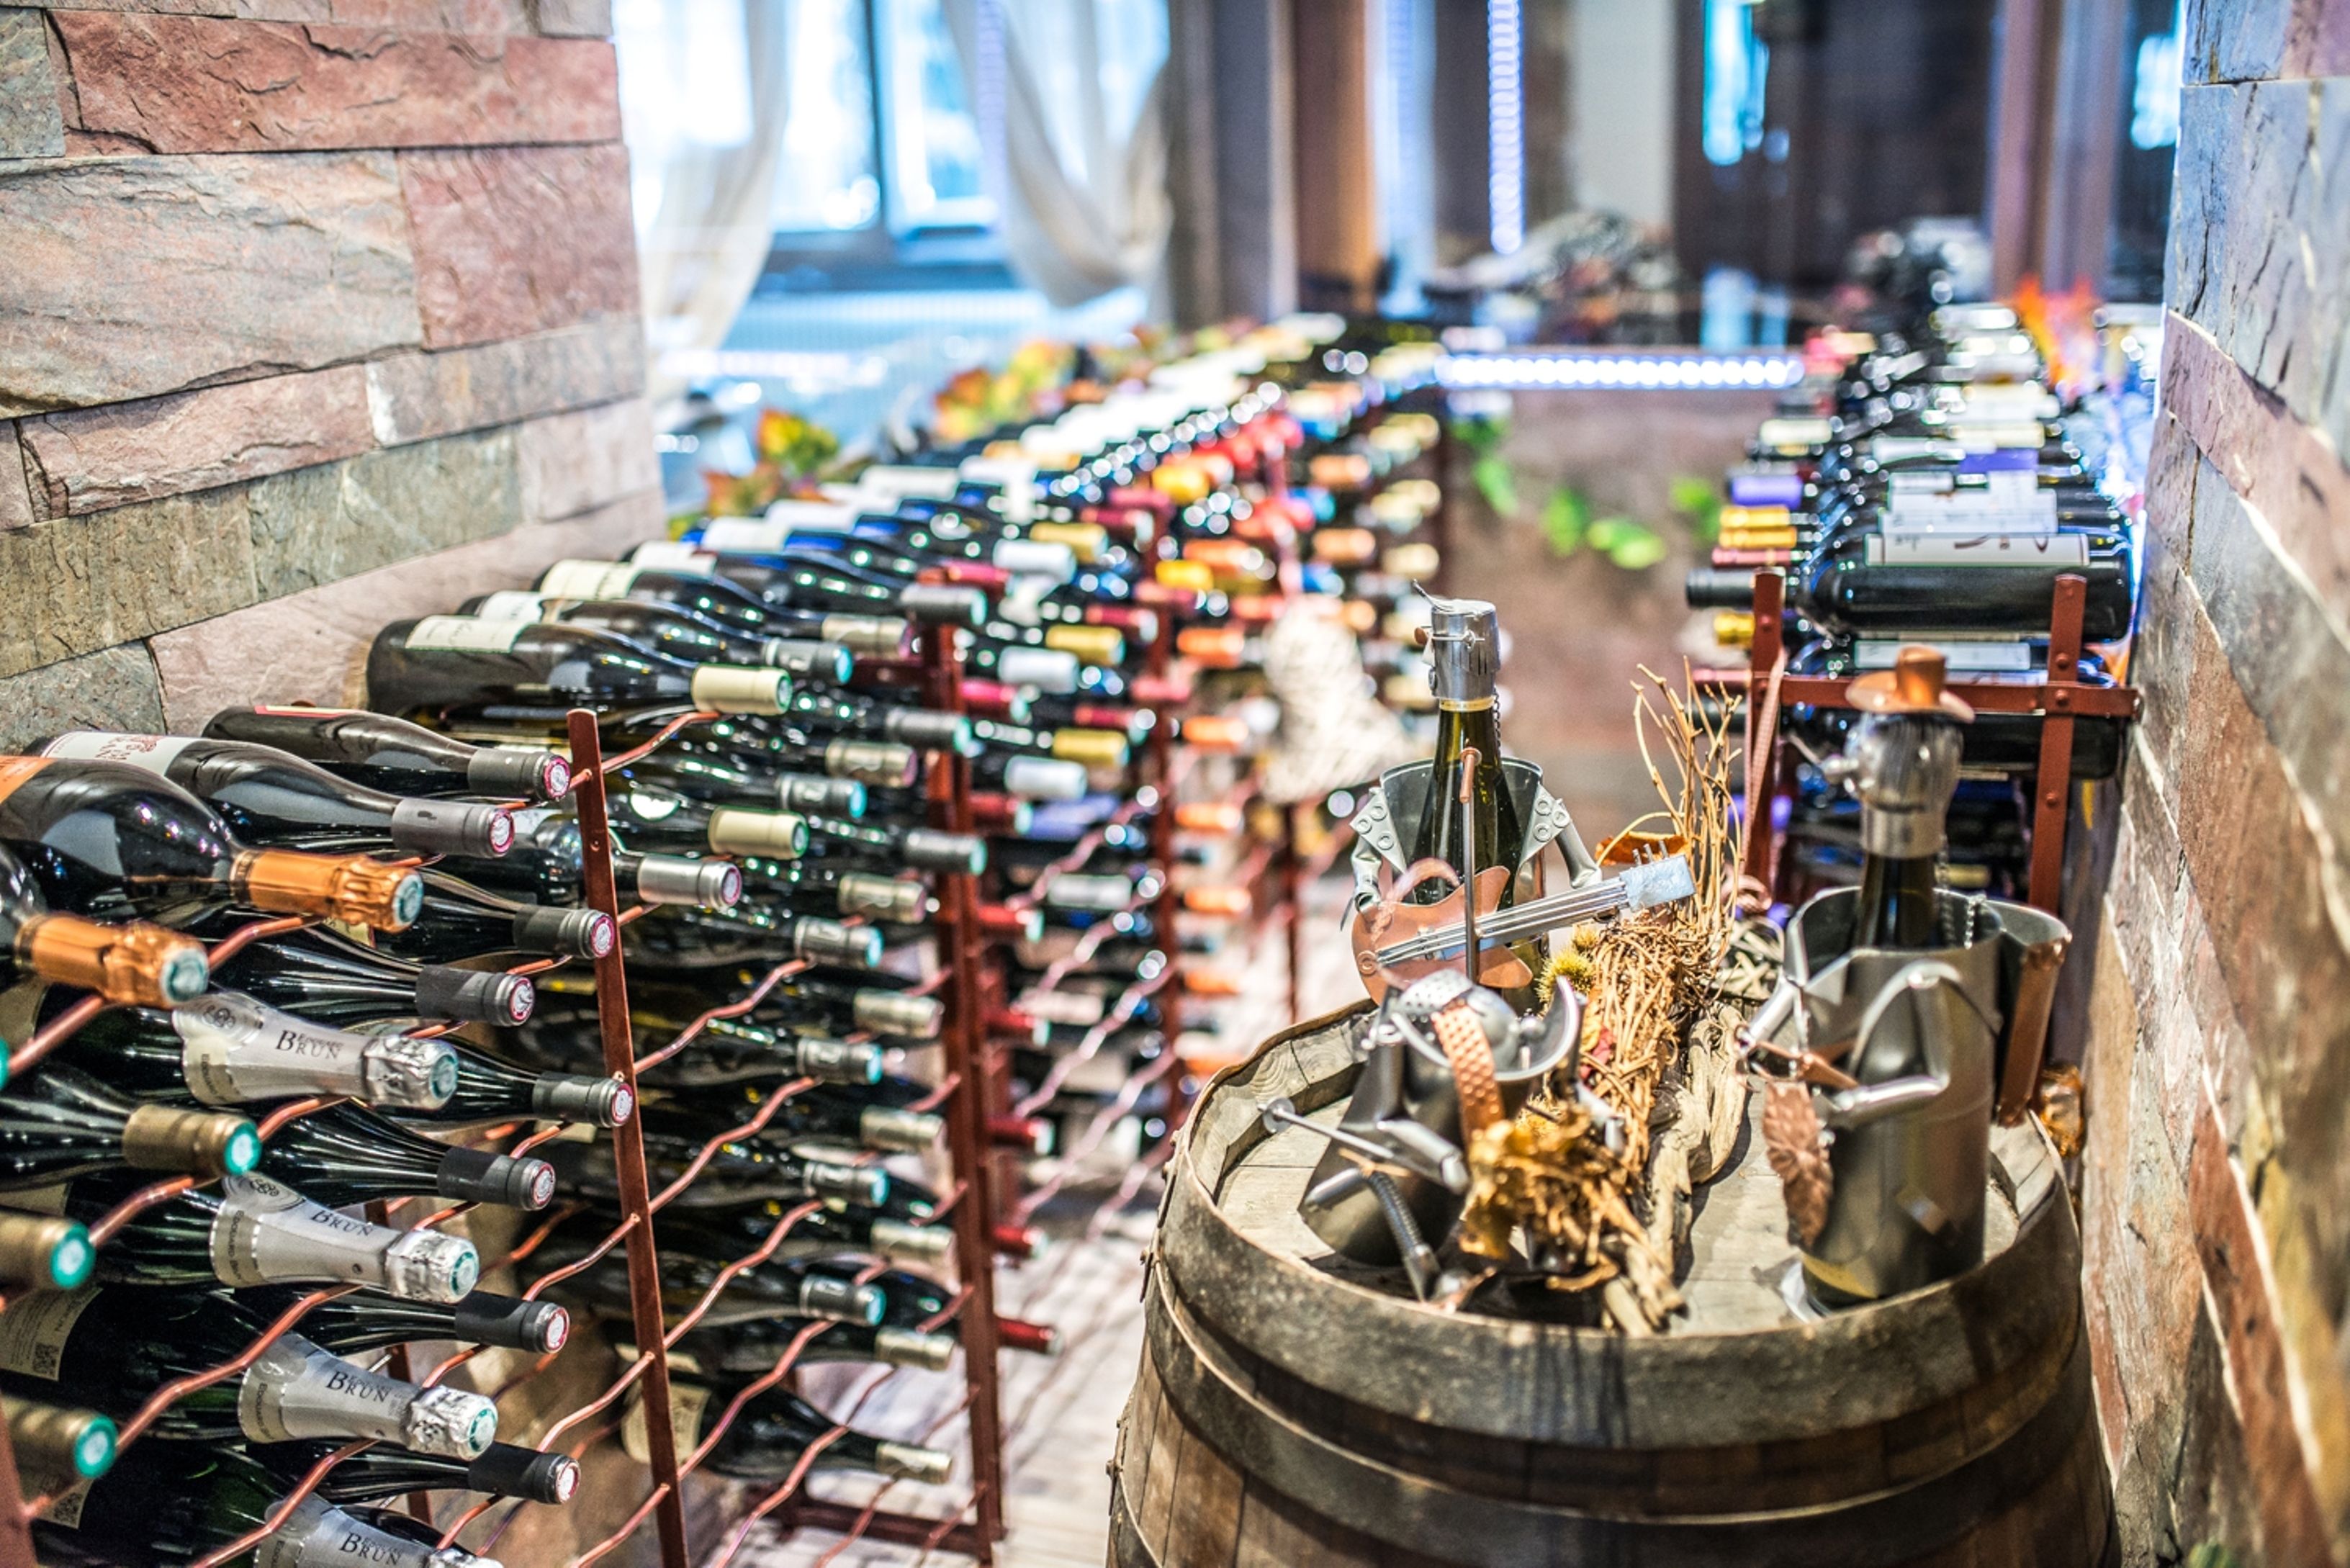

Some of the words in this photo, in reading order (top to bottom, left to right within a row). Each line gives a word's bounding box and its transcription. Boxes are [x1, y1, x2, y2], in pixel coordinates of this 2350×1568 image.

[276, 1029, 341, 1060] BRUN
[310, 1209, 374, 1237] BRUN
[326, 1371, 391, 1402] BRUN
[339, 1532, 402, 1566] BRUN
